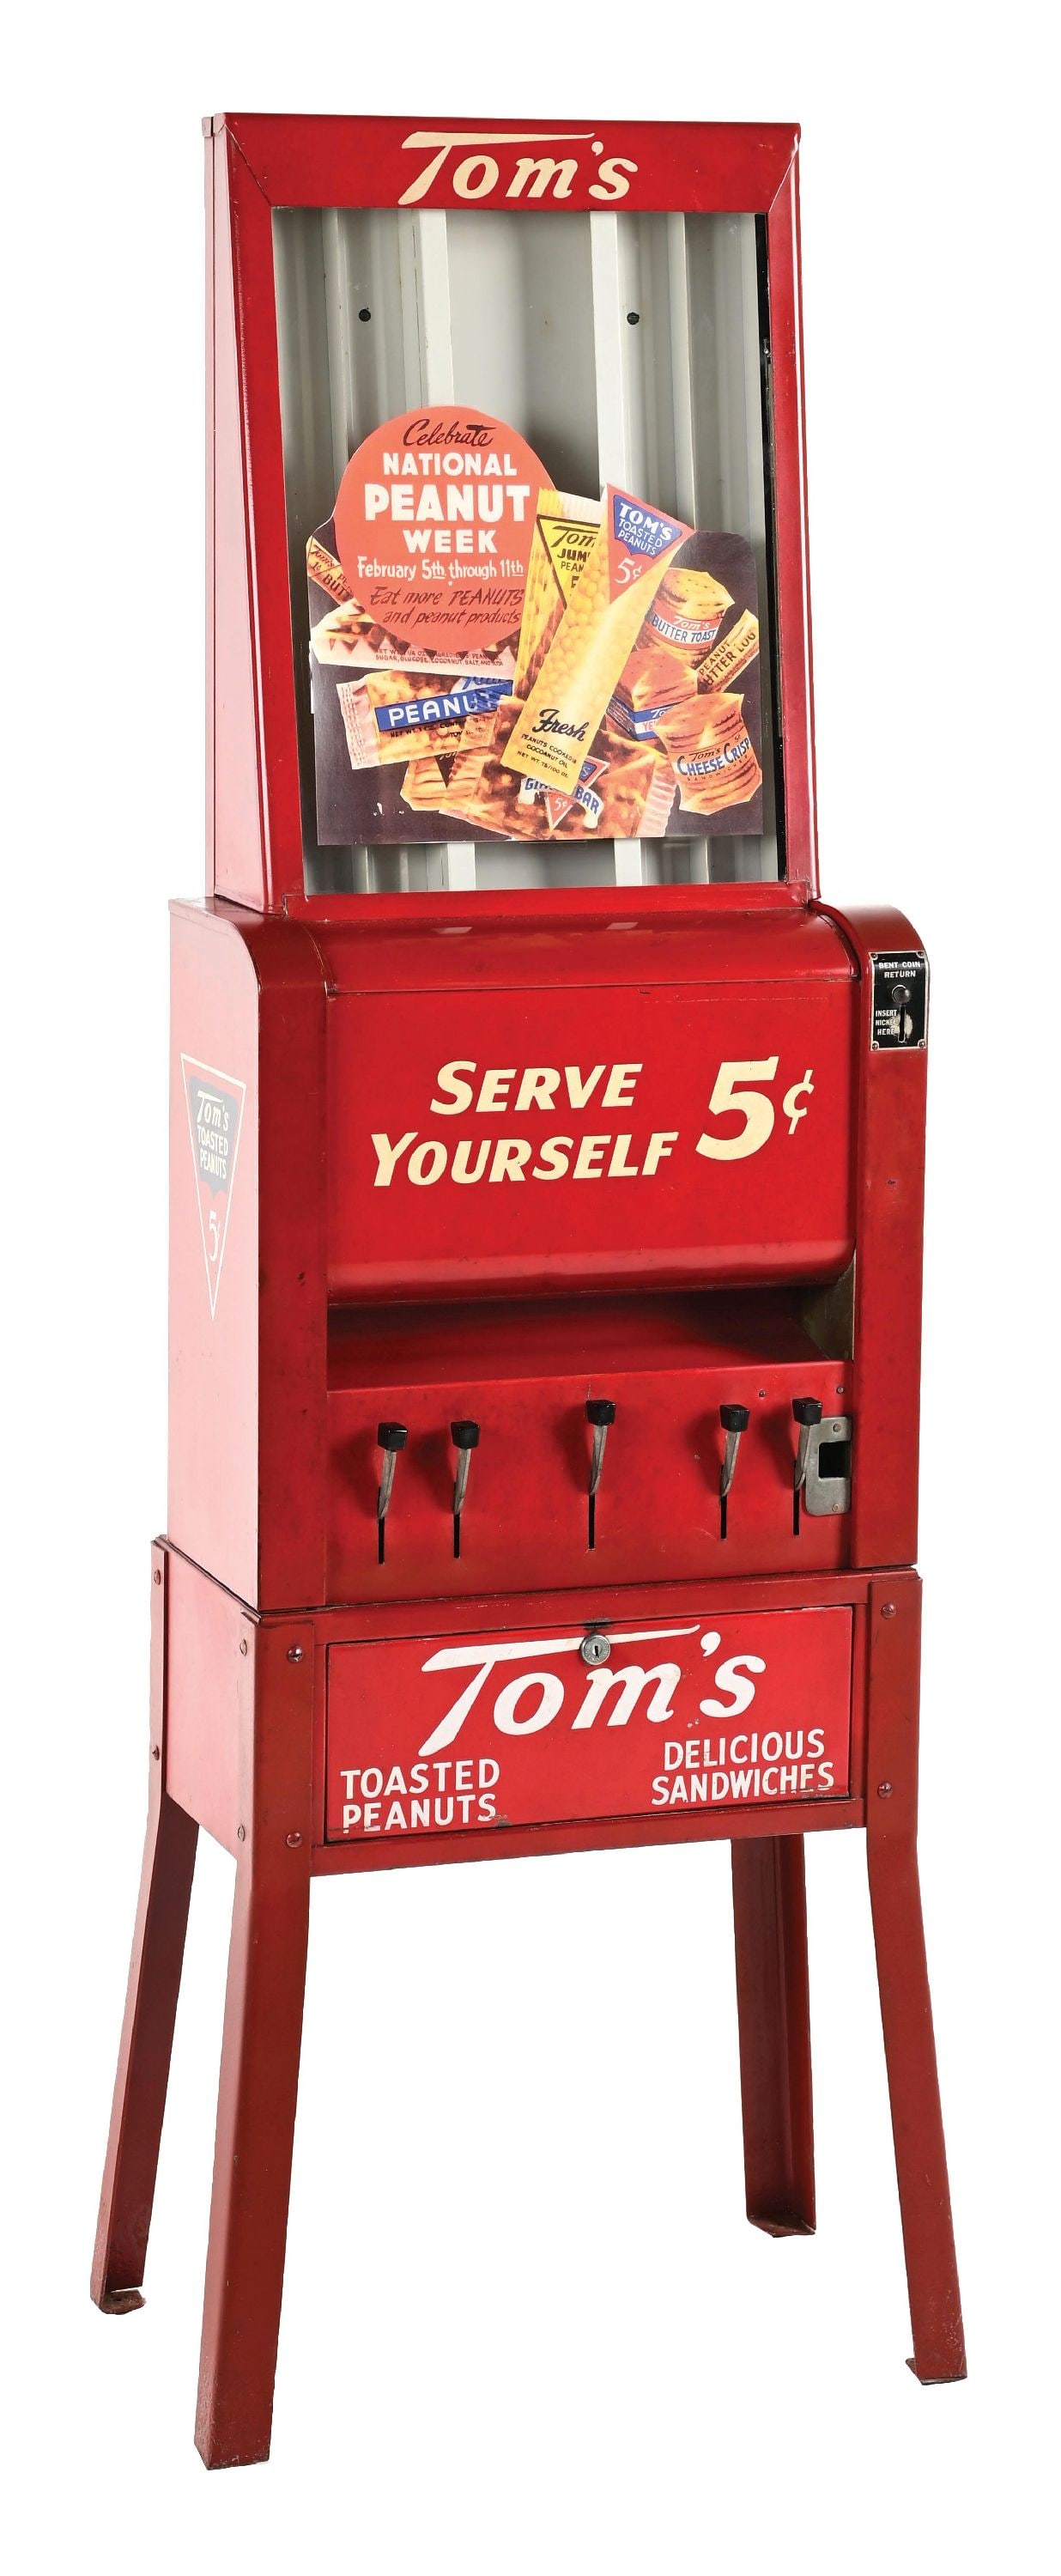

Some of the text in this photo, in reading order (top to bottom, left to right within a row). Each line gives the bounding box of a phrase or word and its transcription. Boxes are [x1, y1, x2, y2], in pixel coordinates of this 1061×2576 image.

[397, 131, 639, 205] Tom's
[403, 418, 497, 447] Celebrate
[383, 453, 518, 477] NATIONAL
[364, 483, 530, 523] PEANUT
[619, 502, 673, 541] TOM'S
[619, 518, 663, 548] TOASTED
[403, 529, 499, 554] WEEK
[618, 531, 657, 556] PEANUTS
[357, 556, 524, 581] February 5th through 11th
[615, 557, 643, 584] 5¢
[370, 586, 524, 606] Eat more PEANUTS
[383, 606, 521, 629] and peanut products
[652, 615, 716, 642] BUTTER TOAST
[672, 615, 711, 630] Tom's
[699, 639, 731, 676] PEANUT
[532, 708, 590, 741] Fresh
[521, 733, 548, 747] PEANUTS
[549, 745, 573, 761] COOKED
[526, 744, 568, 769] COCOANUT OIL
[676, 737, 749, 776] CHEESE CRISP
[688, 747, 721, 762] Tom's
[574, 785, 600, 814] BAR
[883, 970, 916, 979] RETURN
[876, 1009, 898, 1018] INSERT
[429, 1060, 644, 1115] SERVE
[197, 1090, 229, 1132] Tom's
[694, 1055, 815, 1161] 5¢
[197, 1124, 229, 1157] TOASTED
[200, 1147, 227, 1180] PEANUTS
[370, 1131, 680, 1187] YOURSELF
[418, 1625, 767, 1757] Tom's
[664, 1728, 825, 1771] DELICIOUS
[340, 1758, 501, 1800] TOASTED
[651, 1762, 834, 1806] SANDWICHES
[343, 1793, 497, 1834] PEANUTS
